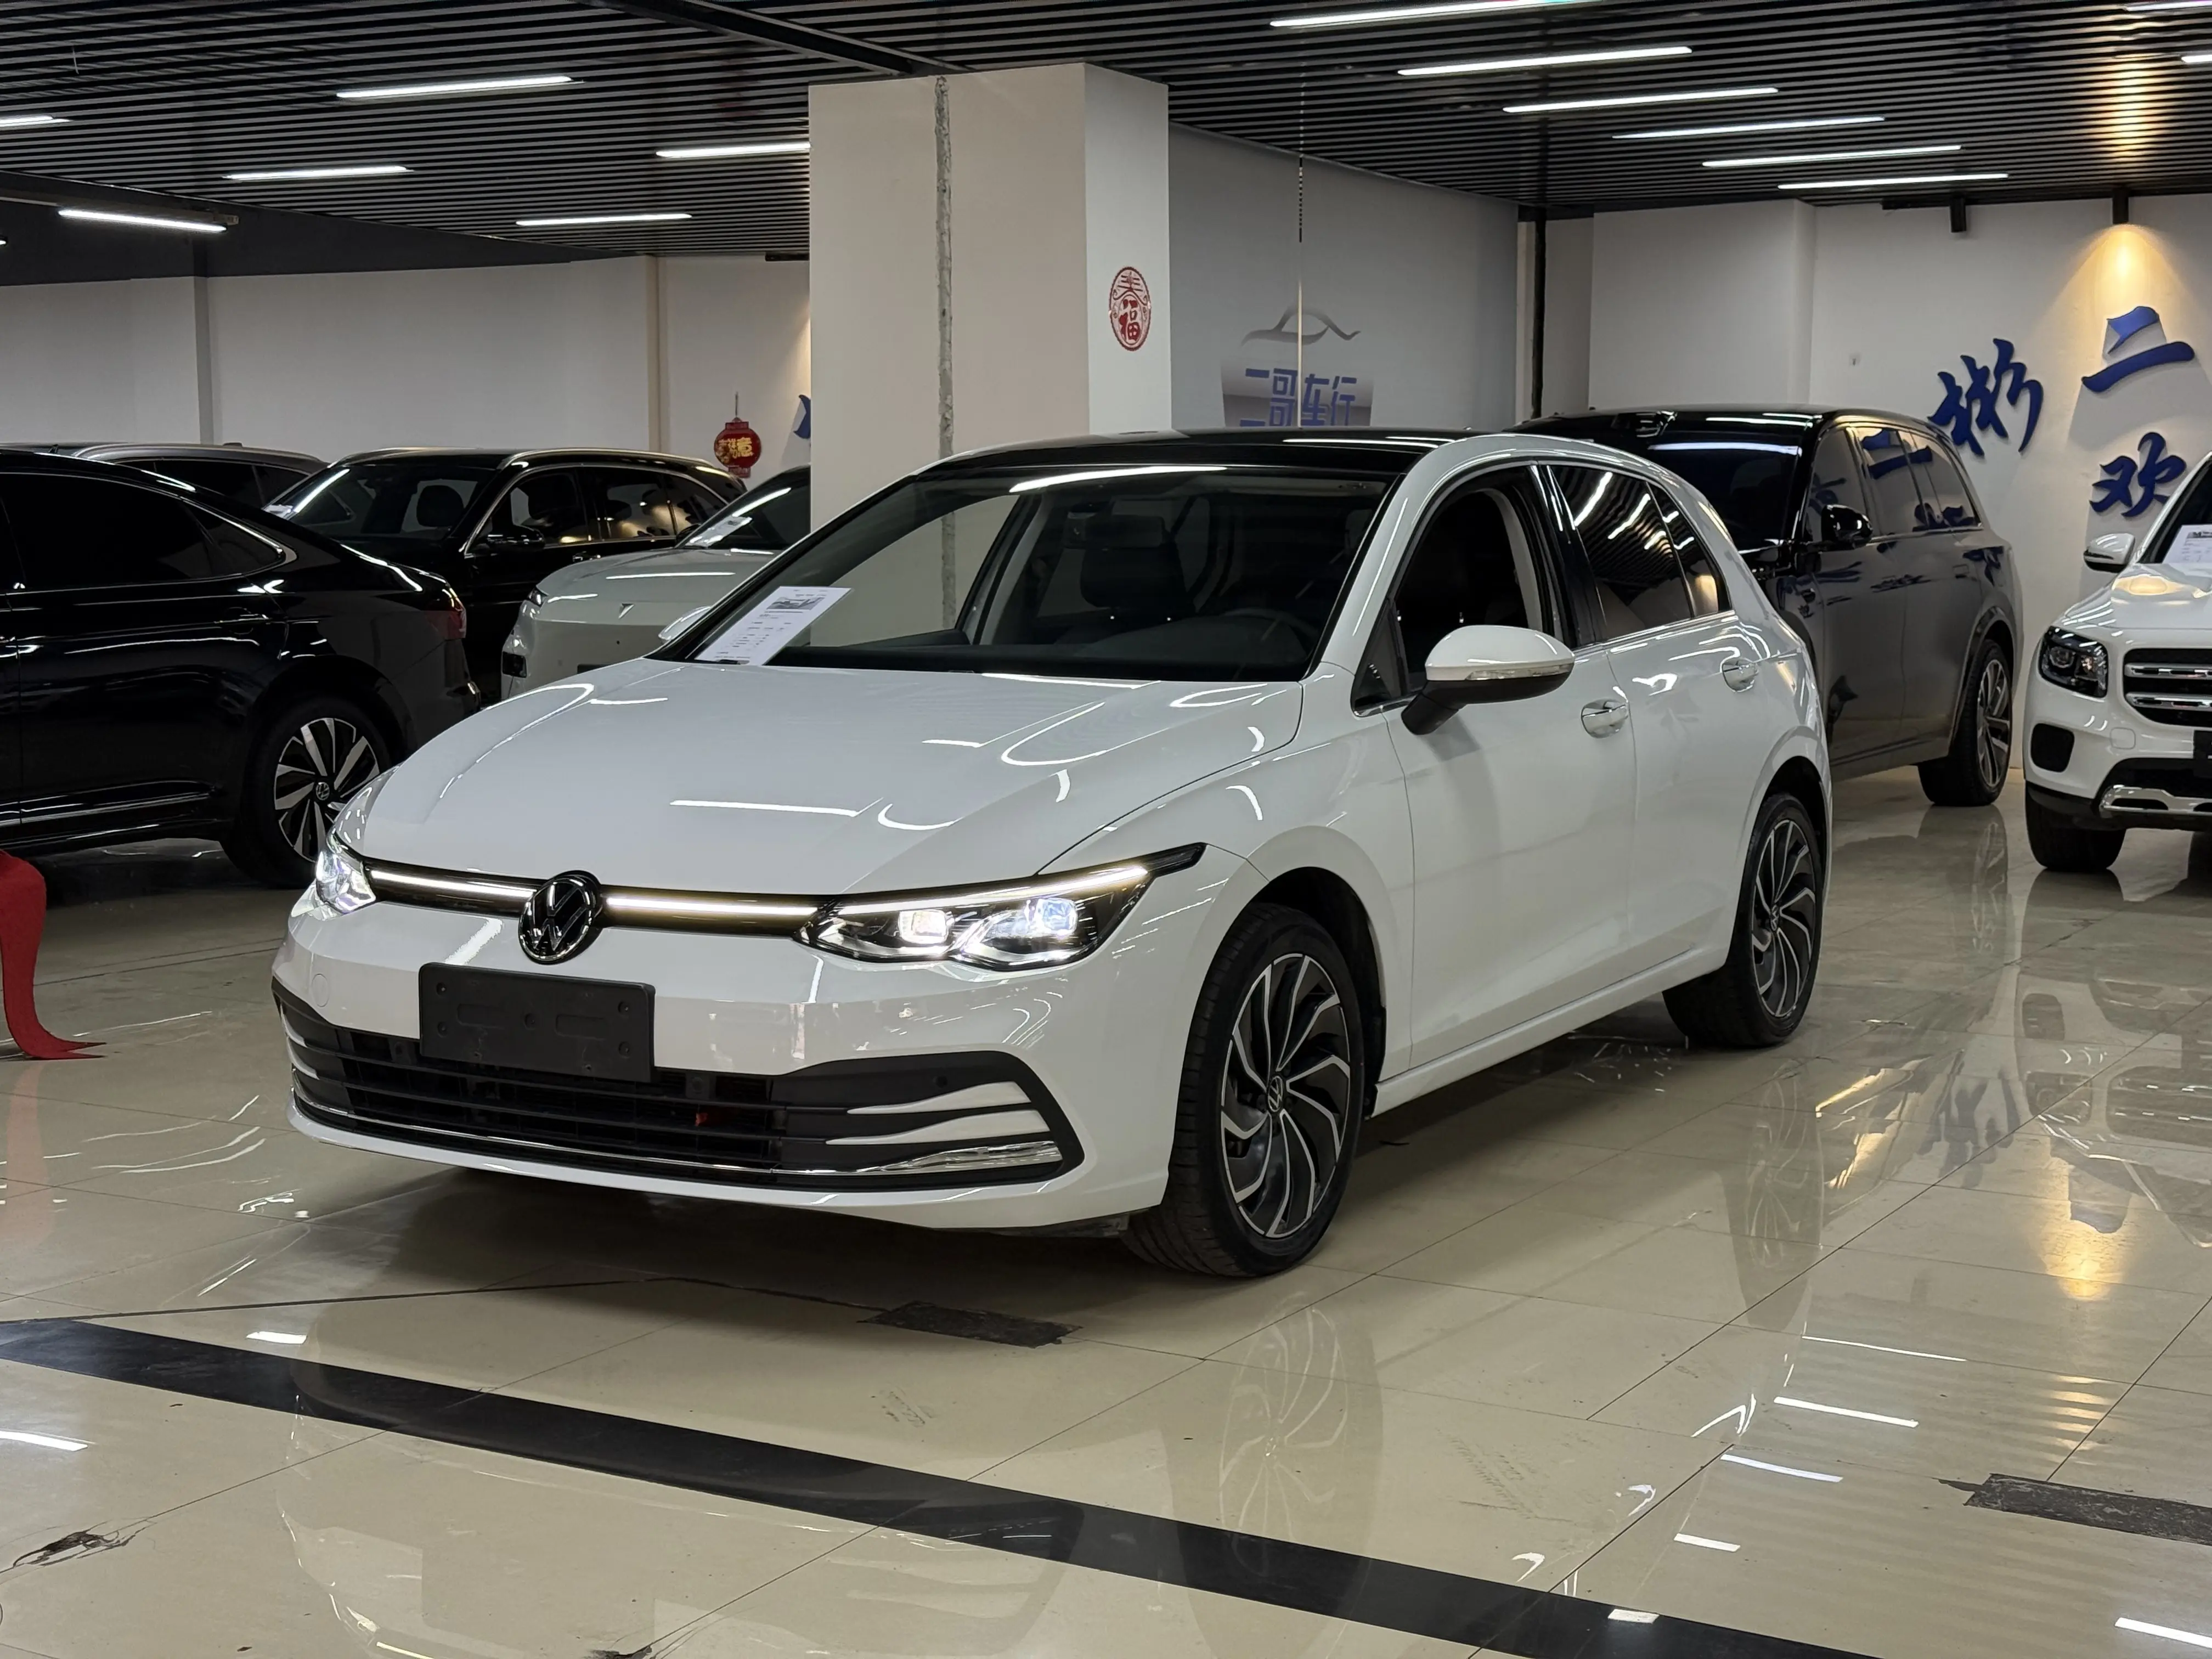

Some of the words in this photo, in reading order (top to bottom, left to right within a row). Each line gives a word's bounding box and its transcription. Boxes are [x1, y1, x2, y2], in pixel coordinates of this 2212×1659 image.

[1240, 368, 1357, 426] 二哥车行
[524, 878, 595, 959] VW
